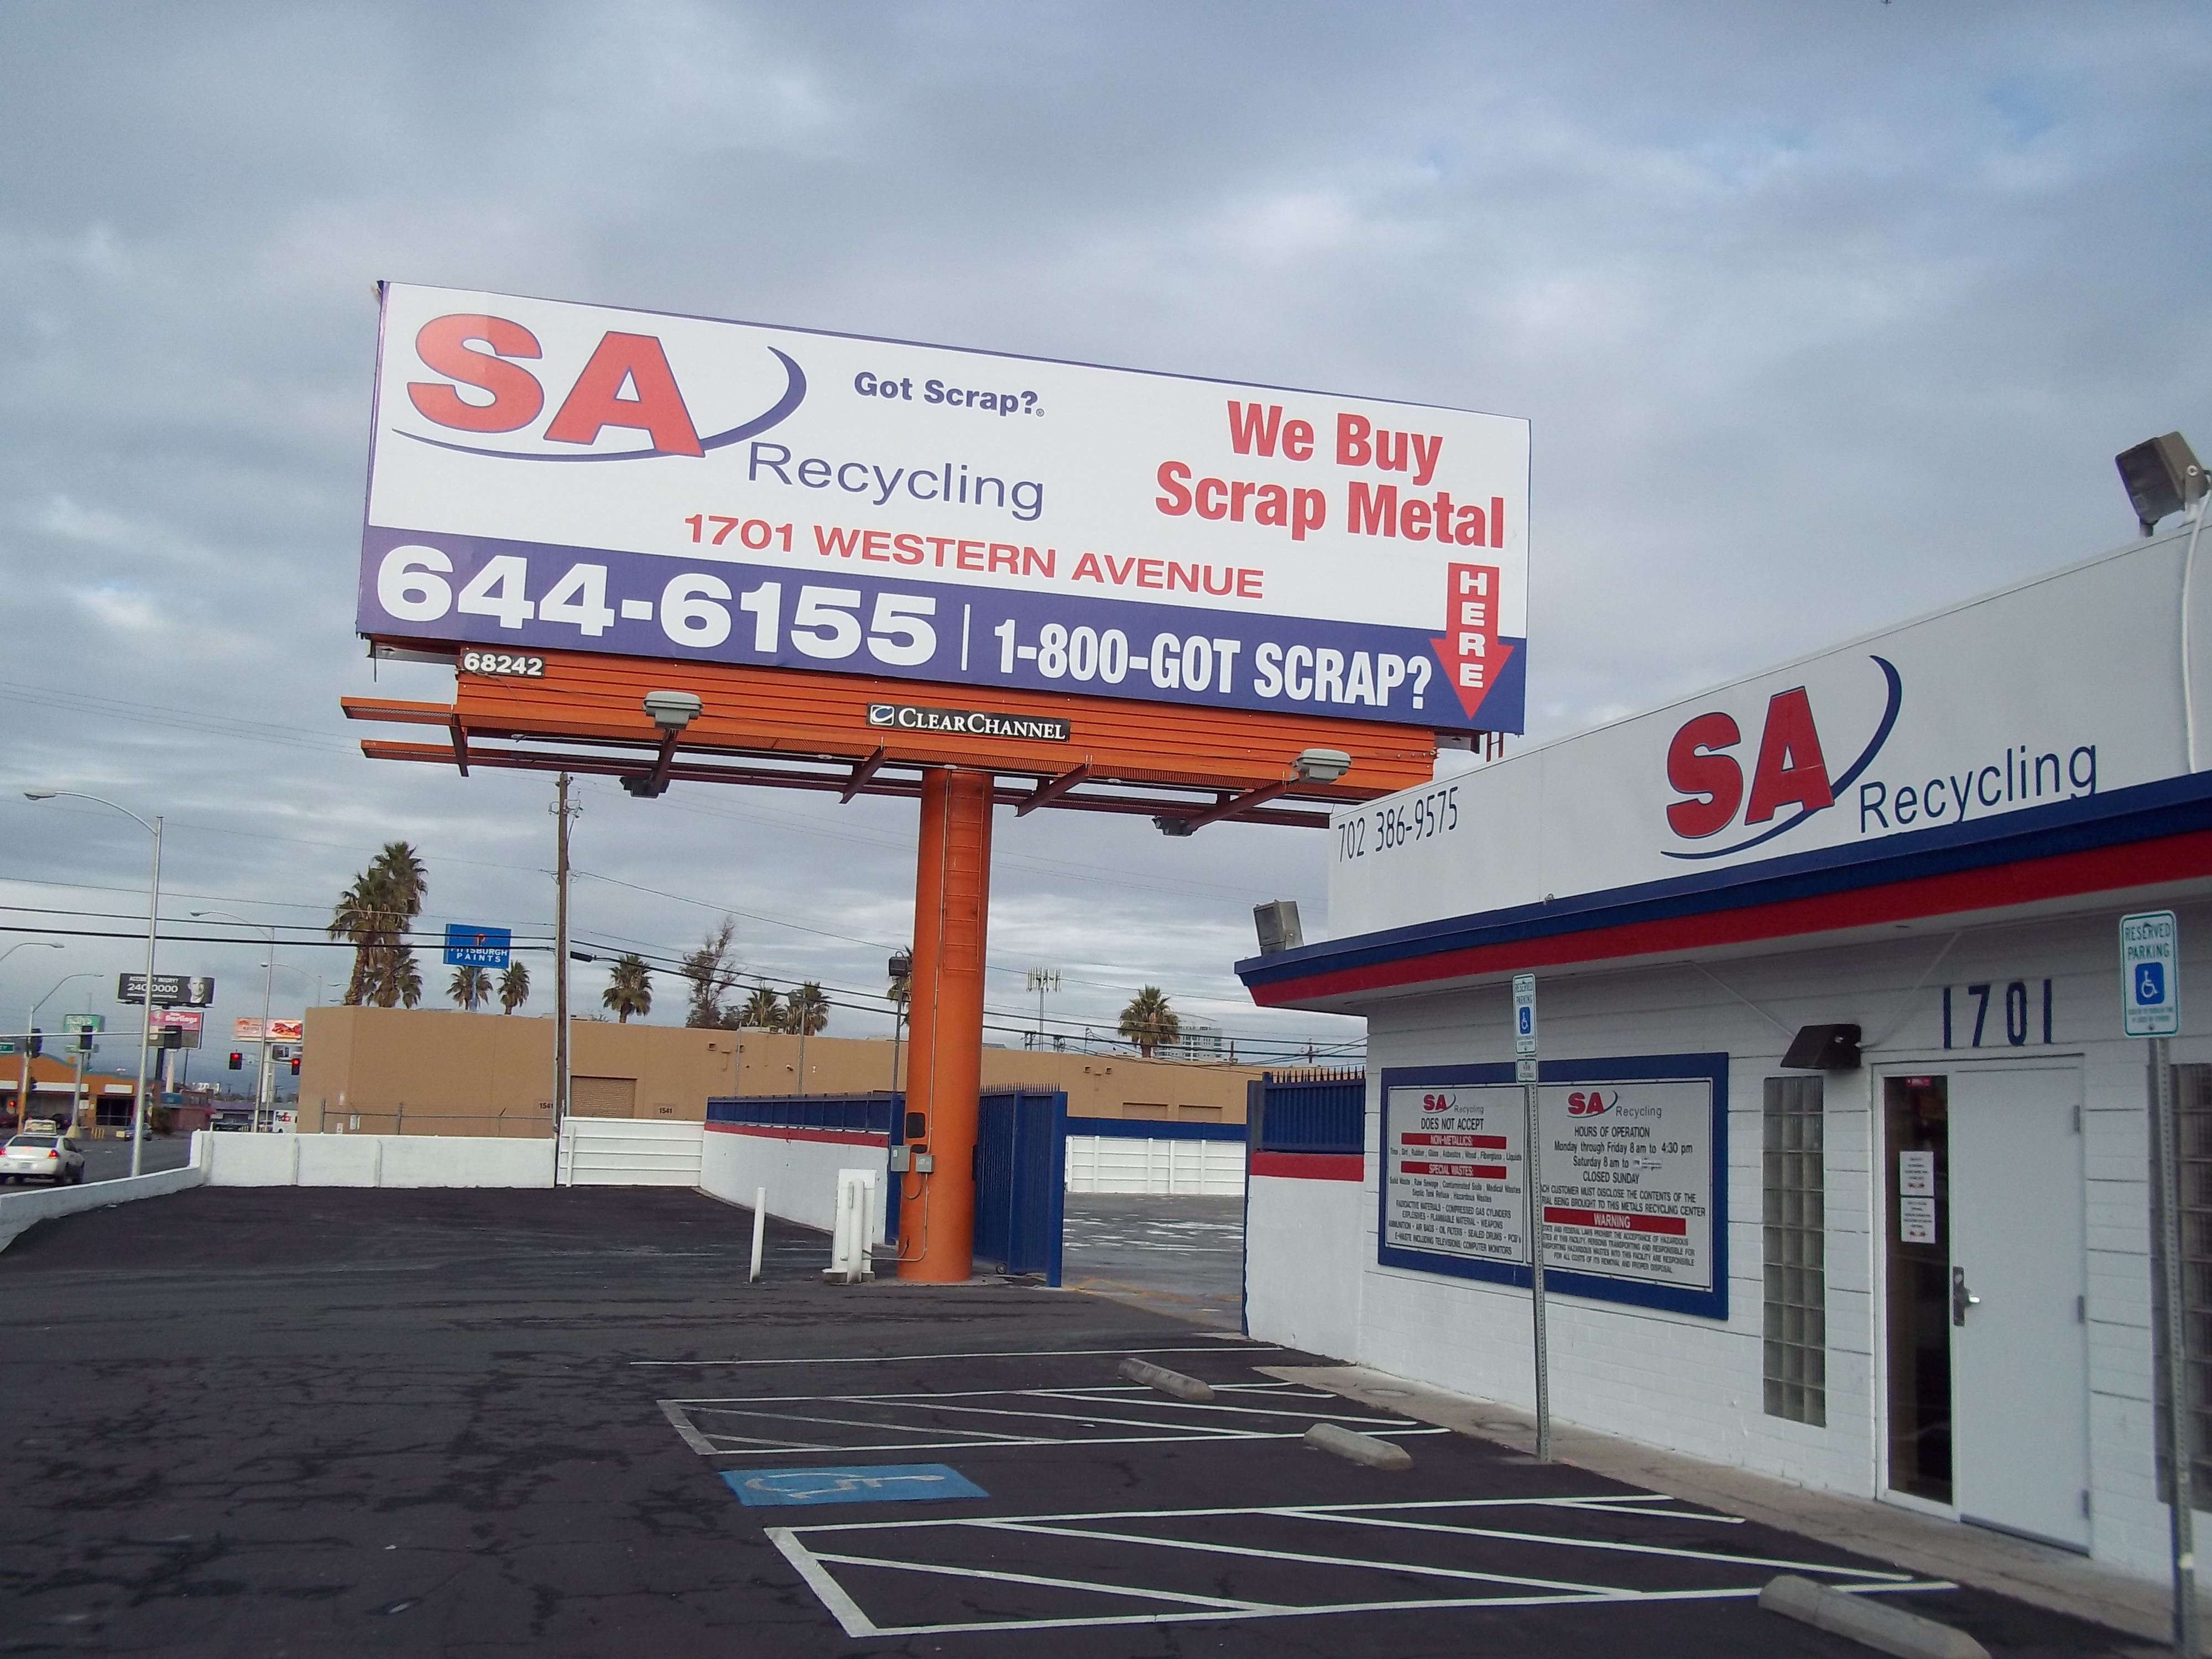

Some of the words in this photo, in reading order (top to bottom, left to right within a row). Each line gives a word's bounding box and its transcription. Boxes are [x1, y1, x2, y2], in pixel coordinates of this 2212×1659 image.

[407, 313, 706, 457] SA
[854, 372, 912, 400] Got
[1227, 400, 1314, 461] We
[1337, 413, 1443, 486] Buy
[748, 442, 1044, 520] Recycling
[1156, 461, 1326, 541] Scrap
[1347, 481, 1504, 548] Metal
[685, 514, 792, 552] 1701
[814, 525, 1055, 577] WESTERN
[1072, 552, 1264, 598] AVENUE
[377, 545, 937, 665] 644-6155
[1459, 571, 1487, 688] HERE
[463, 653, 543, 676] 68242
[995, 619, 1241, 693] 1-800-GOT
[1254, 642, 1432, 709] SCRAP?
[1666, 686, 1834, 838] SA
[1860, 745, 2096, 833] Recycling
[1338, 817, 1365, 863] 702
[1376, 786, 1458, 852] 386-9575
[2125, 922, 2170, 940] RESERVED
[457, 953, 500, 962] PAINTS
[2128, 943, 2169, 960] PARKING
[1943, 979, 2052, 1049] 1701
[1423, 1094, 1447, 1110] SA
[1454, 1105, 1484, 1114] Recycling
[1568, 1092, 1604, 1114] SA
[1616, 1106, 1662, 1118] Recycling
[1421, 1118, 1438, 1129] DOES
[1442, 1118, 1454, 1130] NOT
[1457, 1118, 1484, 1130] ACCEPT
[1575, 1126, 1597, 1137] HOURS
[1600, 1126, 1609, 1137] OF
[1611, 1126, 1650, 1138] OPERATION
[1554, 1140, 1577, 1153] Monday
[1580, 1141, 1604, 1155] through
[1608, 1141, 1627, 1155] Friday
[1630, 1142, 1634, 1152] 8
[1636, 1145, 1646, 1153] am
[1650, 1143, 1656, 1154] to
[1662, 1142, 1678, 1153] 4:30
[1681, 1144, 1693, 1155] pm
[1429, 1165, 1449, 1175] SPECIAL
[1573, 1156, 1601, 1169] Saturday
[1604, 1157, 1608, 1167] 8
[1623, 1158, 1629, 1168] to
[1583, 1171, 1610, 1182] CLOSED
[1613, 1172, 1639, 1184] SUNDAY
[1551, 1186, 1579, 1195] CUSTOMER
[1581, 1187, 1594, 1196] MUST
[1598, 1188, 1624, 1199] DISCLOSE
[1627, 1190, 1637, 1199] THE
[1640, 1191, 1671, 1202] CONTENTS
[1673, 1192, 1682, 1202] OF
[1684, 1193, 1696, 1203] THE
[1475, 1207, 1484, 1215] GAS
[1554, 1197, 1569, 1207] BEING
[1571, 1198, 1595, 1208] BROUGHT
[1598, 1199, 1605, 1209] TO
[1608, 1200, 1619, 1210] THIS
[1621, 1202, 1643, 1212] METALS
[1645, 1203, 1677, 1215] RECYCLING
[1681, 1206, 1705, 1217] CENTER
[1594, 1213, 1630, 1228] WARNING
